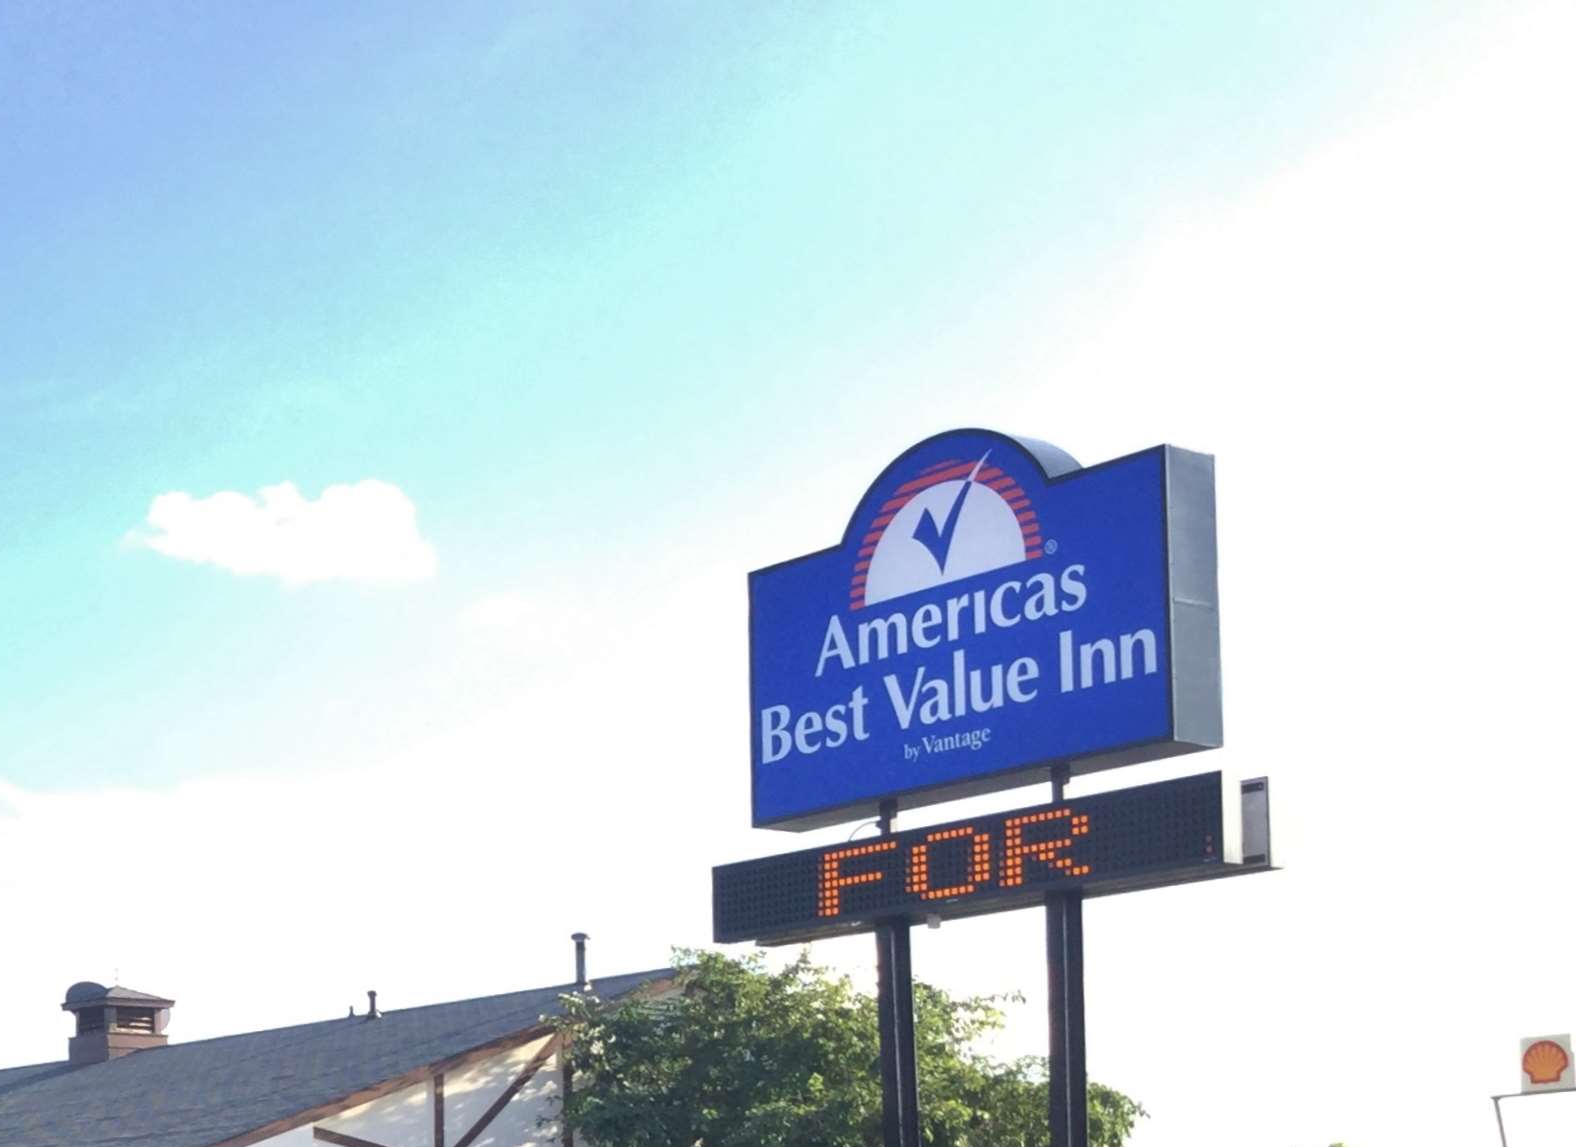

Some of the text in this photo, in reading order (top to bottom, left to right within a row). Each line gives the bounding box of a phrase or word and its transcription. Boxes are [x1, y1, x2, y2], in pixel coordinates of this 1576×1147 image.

[815, 563, 1087, 677] Americas
[761, 628, 1158, 764] Best Value Inn
[904, 727, 992, 762] by Vantage
[817, 808, 1090, 917] FOR
